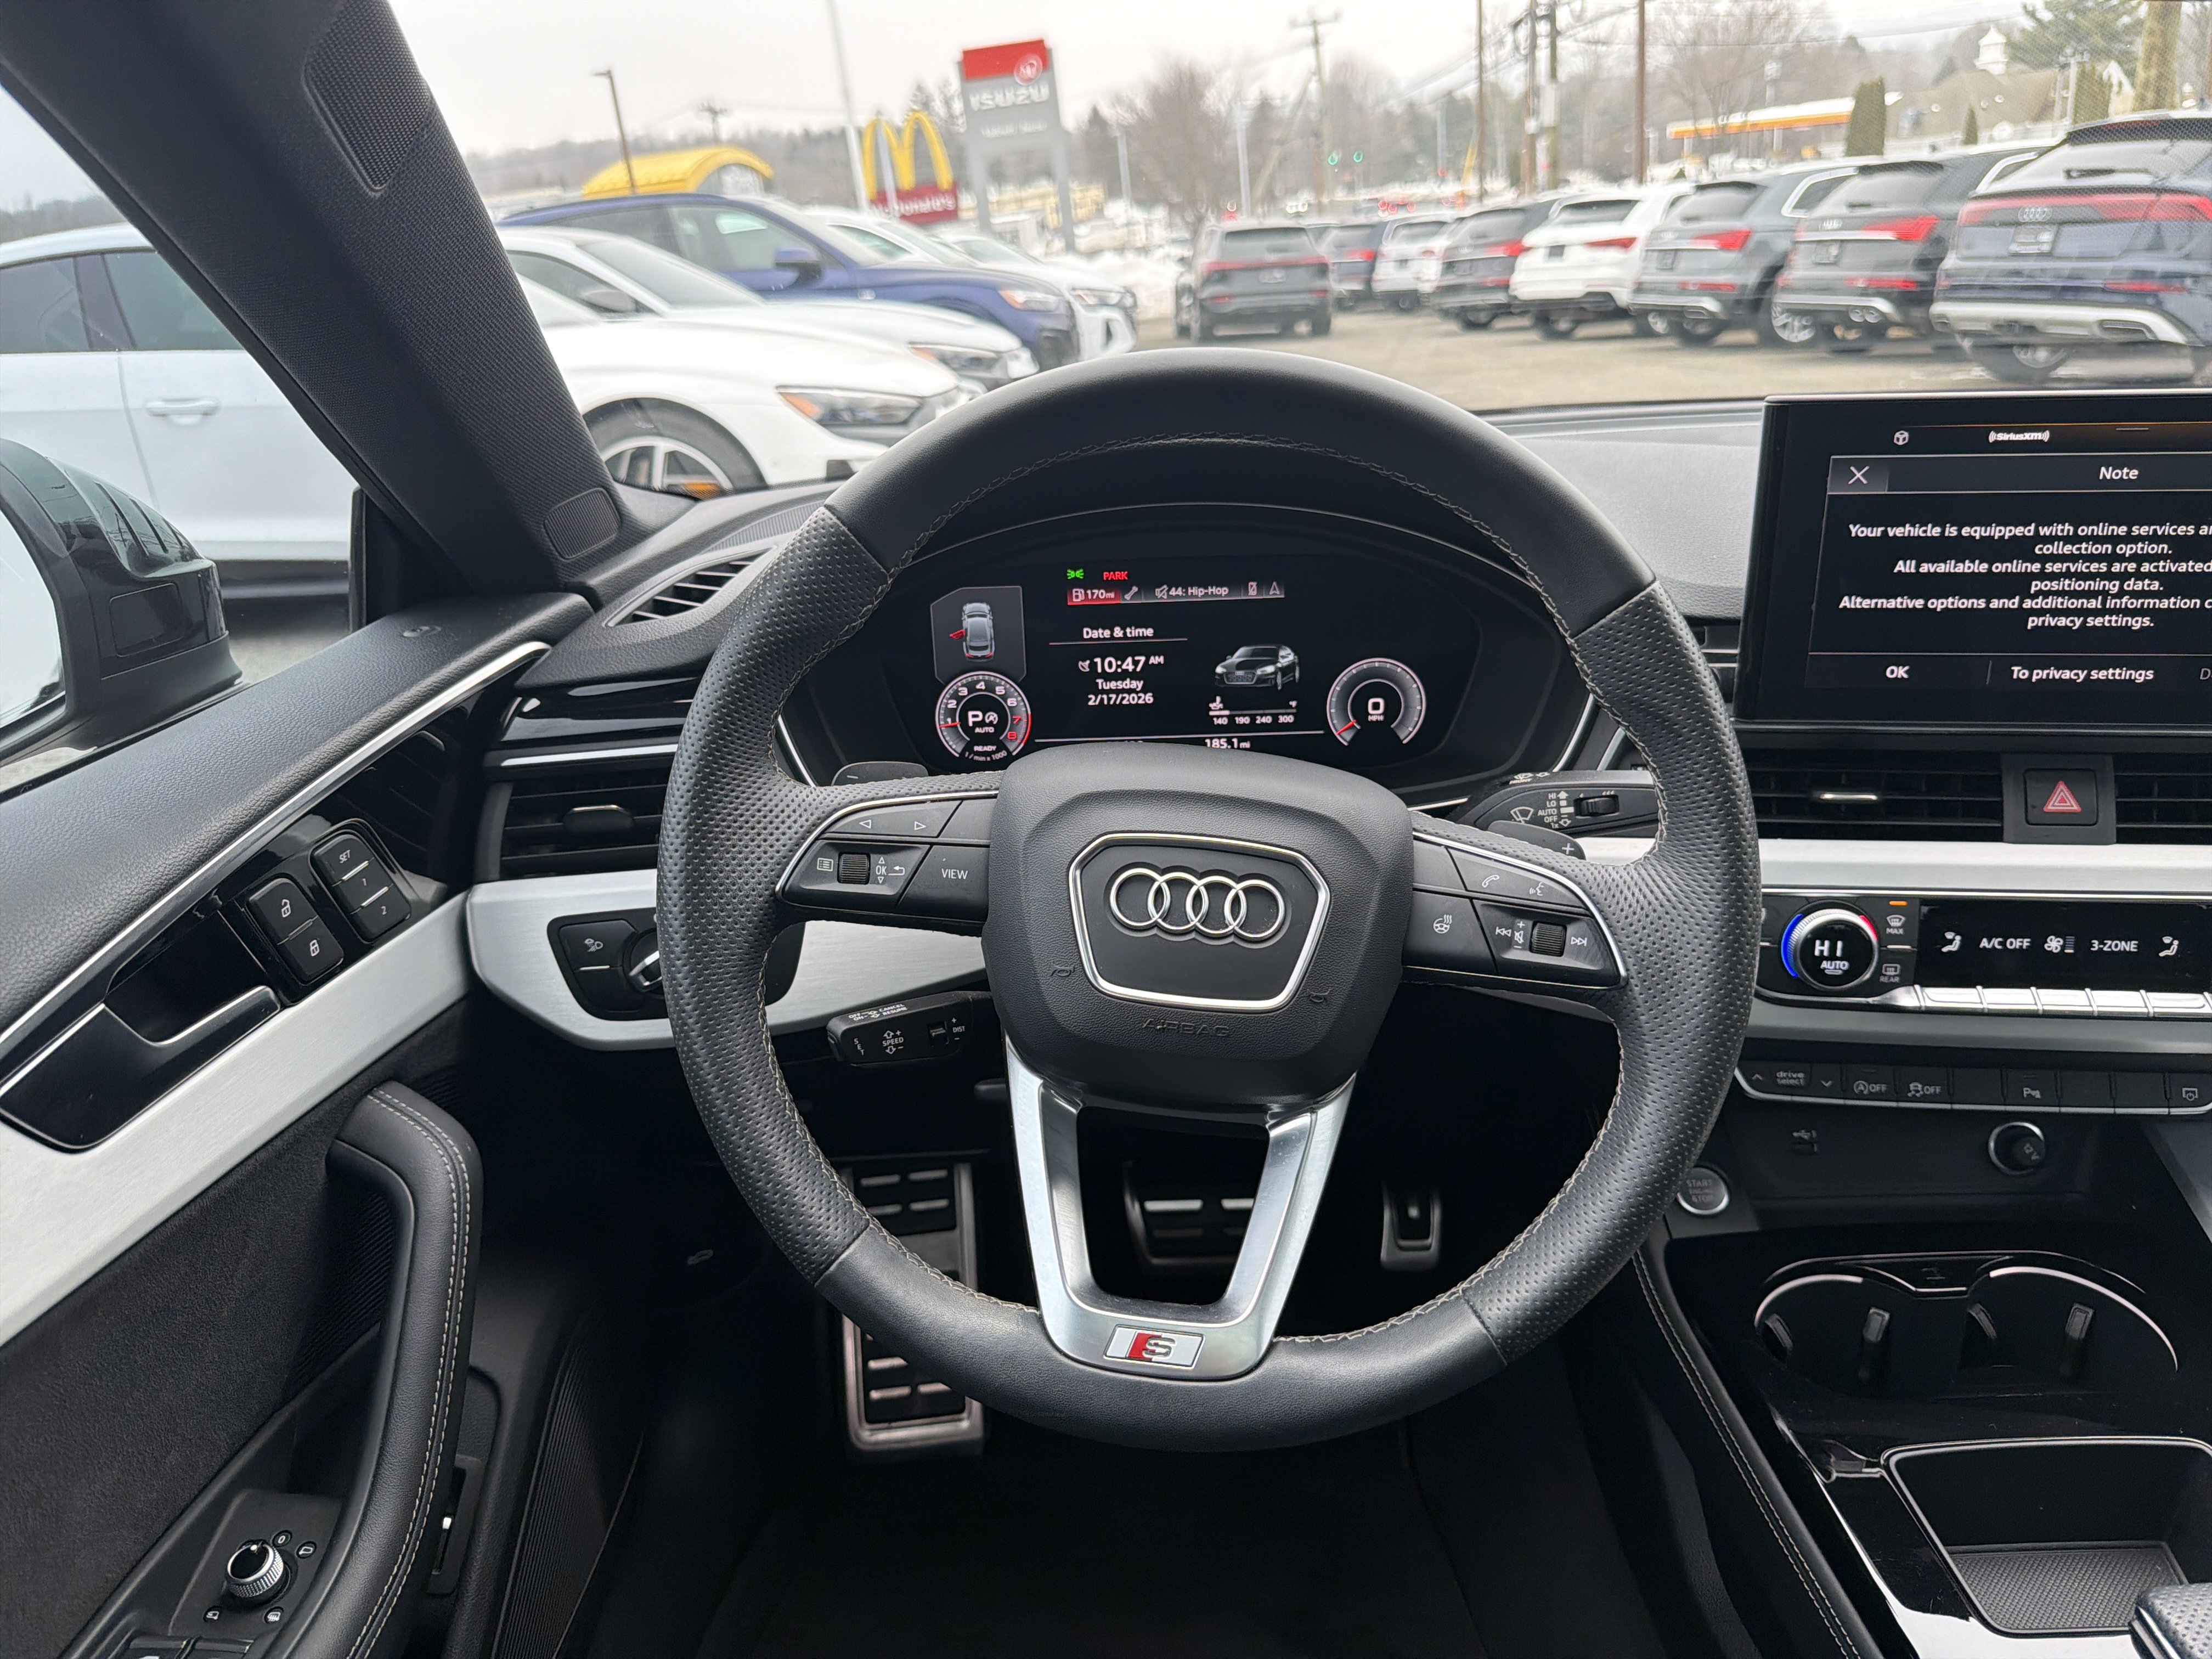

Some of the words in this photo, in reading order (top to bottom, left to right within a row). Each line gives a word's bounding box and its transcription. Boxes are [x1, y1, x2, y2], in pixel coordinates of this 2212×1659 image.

[2099, 466, 2138, 479] Note
[1849, 523, 1886, 537] Your
[1887, 523, 1942, 537] vehicle
[1944, 523, 1958, 537] is
[1961, 522, 2035, 540] equipped
[2038, 522, 2074, 536] with
[2078, 522, 2128, 536] online
[2131, 522, 2195, 535] services
[2034, 541, 2112, 554] collection
[2116, 541, 2172, 557] option.
[1893, 560, 1916, 573] All
[1918, 559, 1989, 573] available
[1991, 559, 2041, 573] online
[2044, 559, 2108, 573] services
[2111, 562, 2137, 572] are
[2140, 559, 2212, 572] activated
[1103, 571, 1128, 580] PARK
[2030, 578, 2120, 594] positioning
[2123, 577, 2164, 590] data.
[1169, 587, 1186, 596] 44:
[1188, 586, 1230, 599] Hip-Hop
[1838, 595, 1925, 608] Alternative
[1927, 596, 1987, 612] options
[1989, 595, 2020, 608] and
[2022, 595, 2102, 608] additional
[2106, 595, 2200, 609] information
[2027, 613, 2084, 630] privacy
[2086, 614, 2154, 630] settings.
[1083, 627, 1111, 639] Date
[1113, 627, 1124, 637] &
[1125, 626, 1154, 637] time
[1093, 656, 1146, 673] 10:47
[1148, 655, 1164, 665] AM
[1886, 665, 1910, 679] OK
[2011, 666, 2029, 679] To
[2032, 667, 2088, 682] privacy
[2090, 667, 2154, 683] settings
[976, 681, 986, 690] 4
[1096, 678, 1144, 691] Tuesday
[958, 687, 969, 696] 3
[995, 686, 1006, 695] 5
[947, 699, 957, 708] 2
[1007, 698, 1017, 706] 6
[1088, 692, 1154, 706] 2/17/2026
[1368, 698, 1385, 714] 0
[967, 710, 984, 727] P
[1012, 715, 1022, 724] 7
[1212, 717, 1228, 725] 140
[1255, 715, 1273, 724] 240
[1278, 715, 1295, 723] 300
[1205, 738, 1238, 749] 185.1
[991, 750, 1007, 760] 1000
[339, 850, 351, 864] SET
[876, 865, 887, 876] OK
[941, 868, 968, 880] VIEW
[362, 878, 367, 887] 1
[381, 906, 387, 916] 2
[1886, 927, 1904, 935] MAX
[1814, 940, 1843, 957] HI
[1979, 938, 2003, 949] A/C
[2006, 938, 2031, 949] OFF
[2090, 940, 2138, 952] 3-ZONE
[1820, 960, 1849, 970] AUTO
[879, 1003, 905, 1012] CANCEL
[1142, 1019, 1229, 1036] AIRBAG
[882, 1037, 904, 1047] SPEED
[1777, 1078, 1805, 1086] select
[1869, 1084, 1887, 1093] OFF
[1923, 1085, 1941, 1094] OFF
